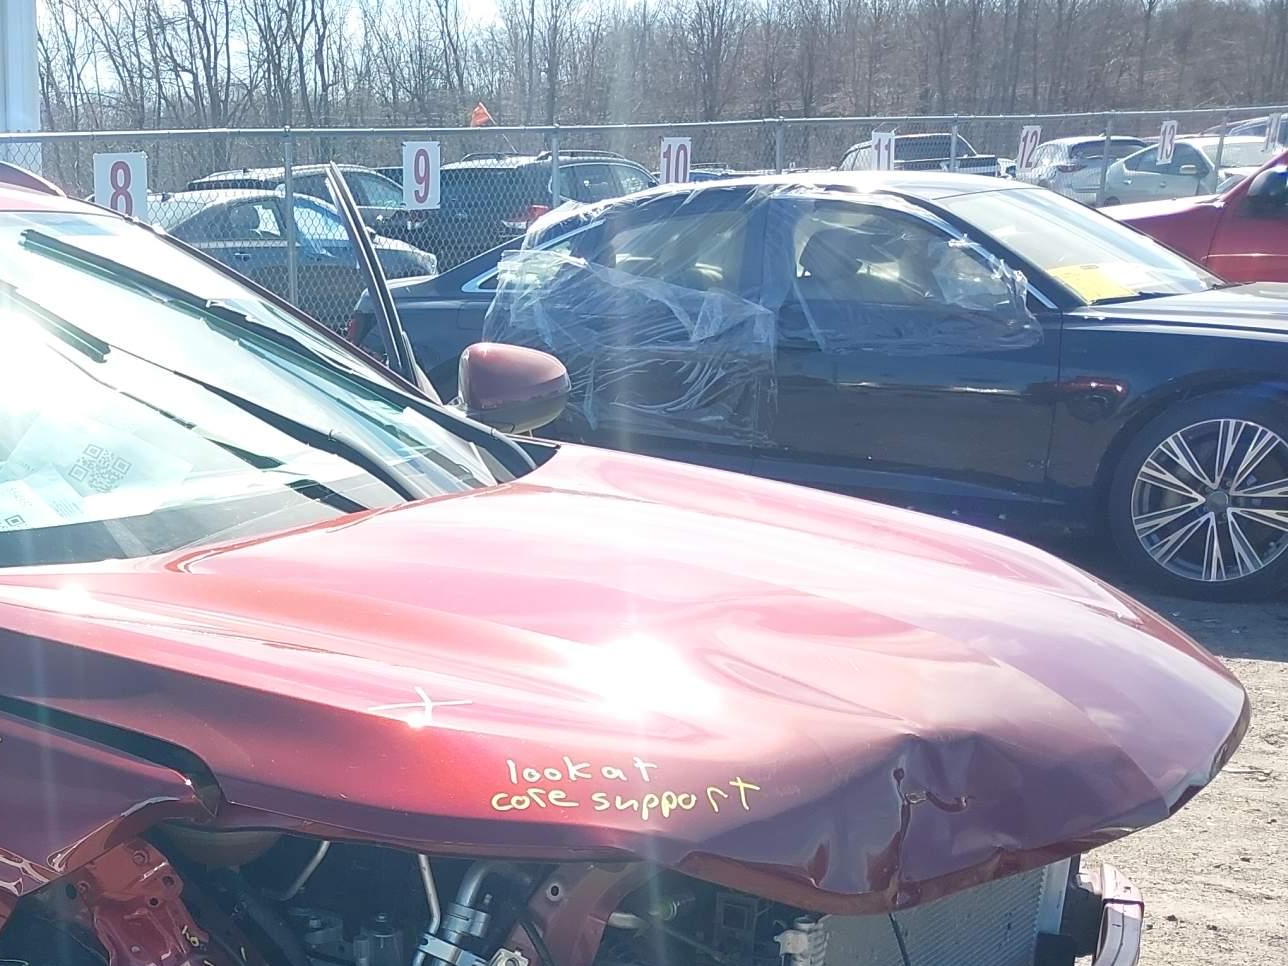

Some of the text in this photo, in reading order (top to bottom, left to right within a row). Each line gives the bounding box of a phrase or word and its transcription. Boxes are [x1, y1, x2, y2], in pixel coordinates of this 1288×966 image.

[874, 137, 892, 171] 11
[1019, 130, 1038, 168] 12
[1160, 125, 1175, 160] 13
[414, 148, 430, 204] 9
[662, 143, 688, 184] 10
[110, 160, 133, 217] 8
[506, 756, 658, 785] look at
[490, 776, 761, 820] core support
